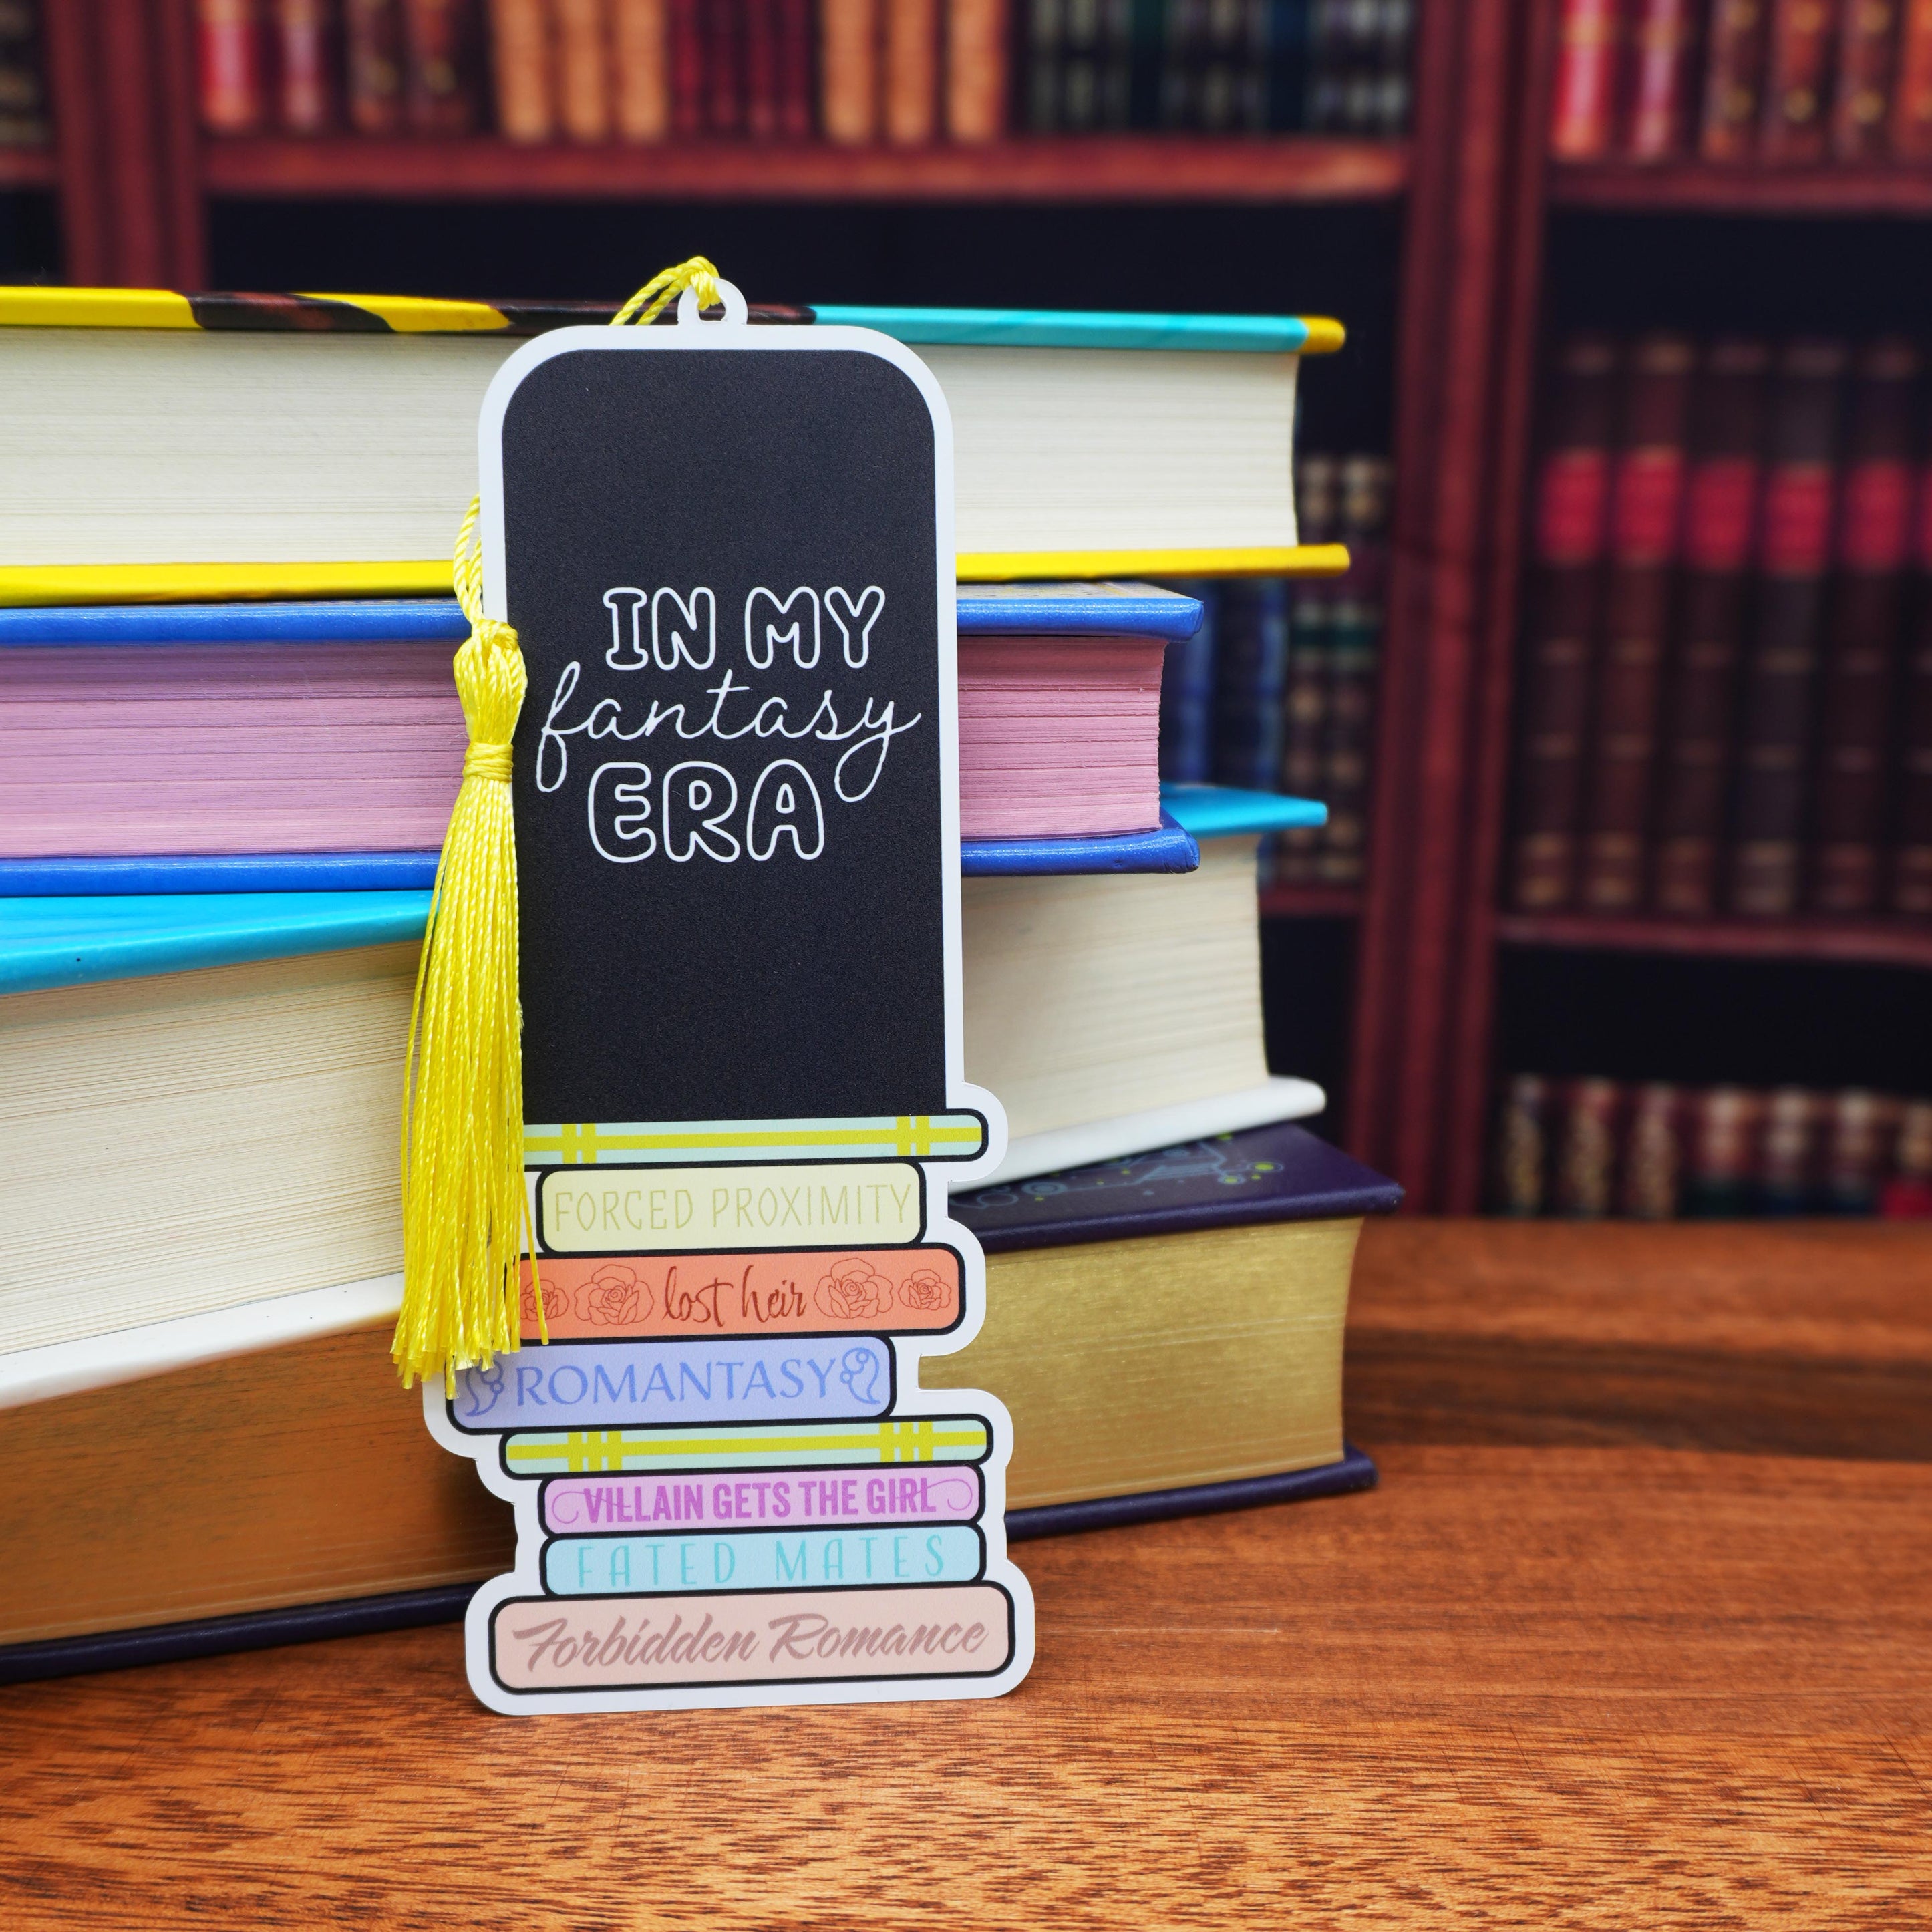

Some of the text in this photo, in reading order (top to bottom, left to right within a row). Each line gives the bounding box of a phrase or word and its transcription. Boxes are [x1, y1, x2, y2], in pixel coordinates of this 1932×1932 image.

[603, 585, 886, 671] IN MY
[536, 661, 922, 803] fantasy
[588, 758, 825, 863] ERA
[554, 1184, 911, 1233] FORCED PROXIMITY
[662, 1265, 807, 1329] lost heir
[516, 1356, 837, 1407] ROMANTASY
[583, 1476, 937, 1525] VILLAIN GETS THE GIRL
[578, 1534, 945, 1589] FATED MATES
[513, 1611, 990, 1673] Forbidden Romance
